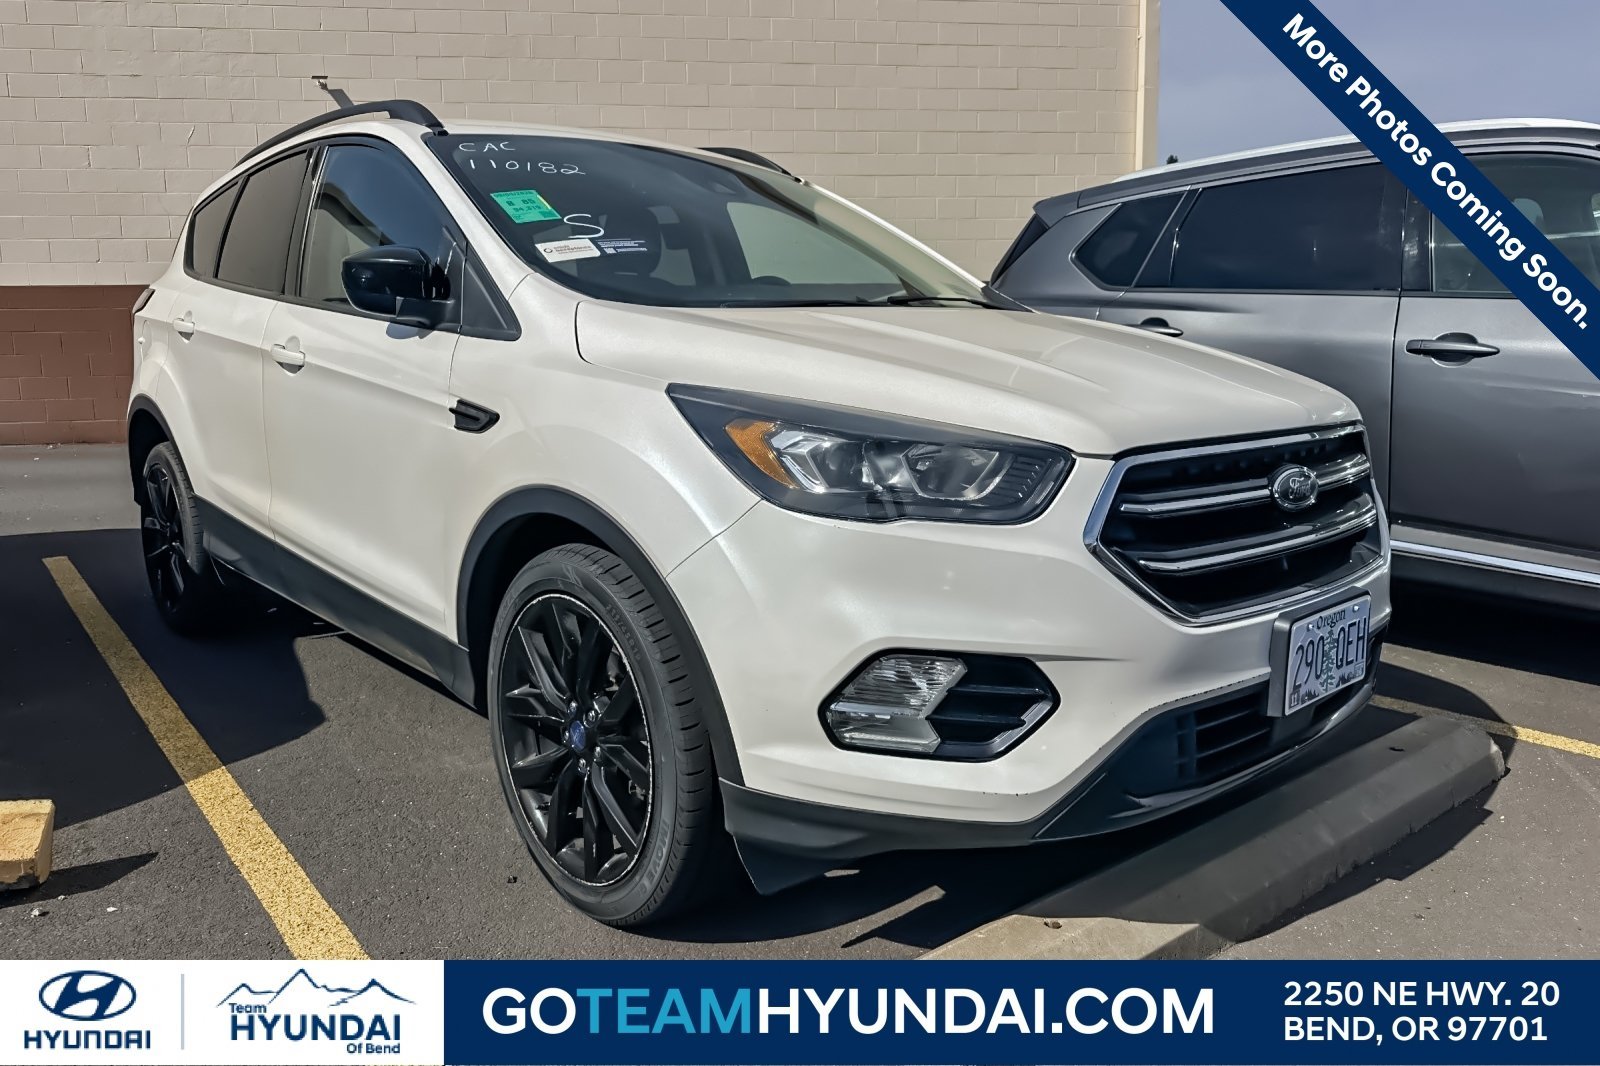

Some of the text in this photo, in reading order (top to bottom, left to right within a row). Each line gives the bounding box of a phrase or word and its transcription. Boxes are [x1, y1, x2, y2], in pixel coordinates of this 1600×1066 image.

[458, 141, 516, 152] CAC
[469, 158, 586, 175] 110182
[563, 213, 605, 239] S
[1316, 609, 1346, 629] Oregon
[1292, 635, 1325, 691] 290
